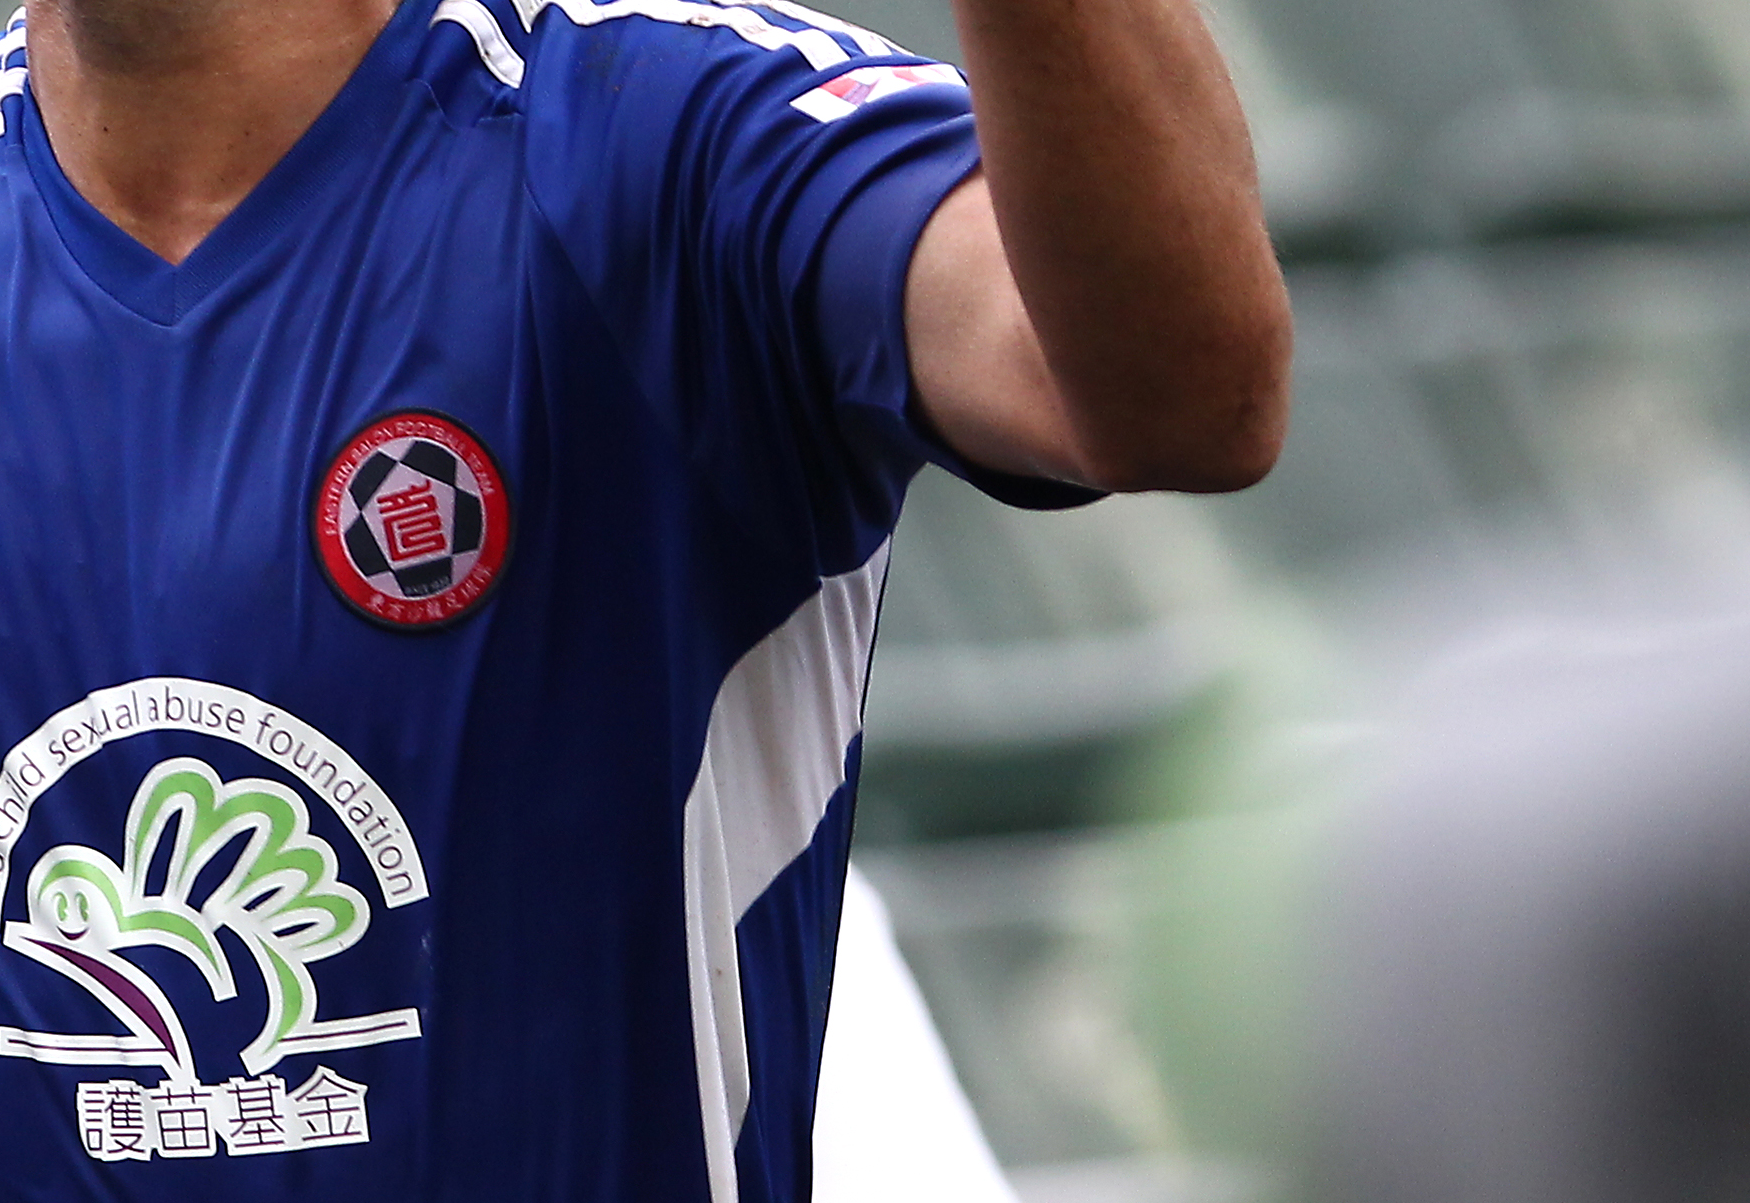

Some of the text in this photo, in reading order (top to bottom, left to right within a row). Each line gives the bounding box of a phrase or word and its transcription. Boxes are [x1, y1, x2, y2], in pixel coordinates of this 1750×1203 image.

[395, 420, 466, 453] FOOTBALL
[467, 452, 496, 496] TEAM
[48, 690, 140, 767] sexual
[149, 685, 246, 734] abuse
[256, 712, 413, 896] foundation
[84, 1074, 362, 1154] 護苗基金
